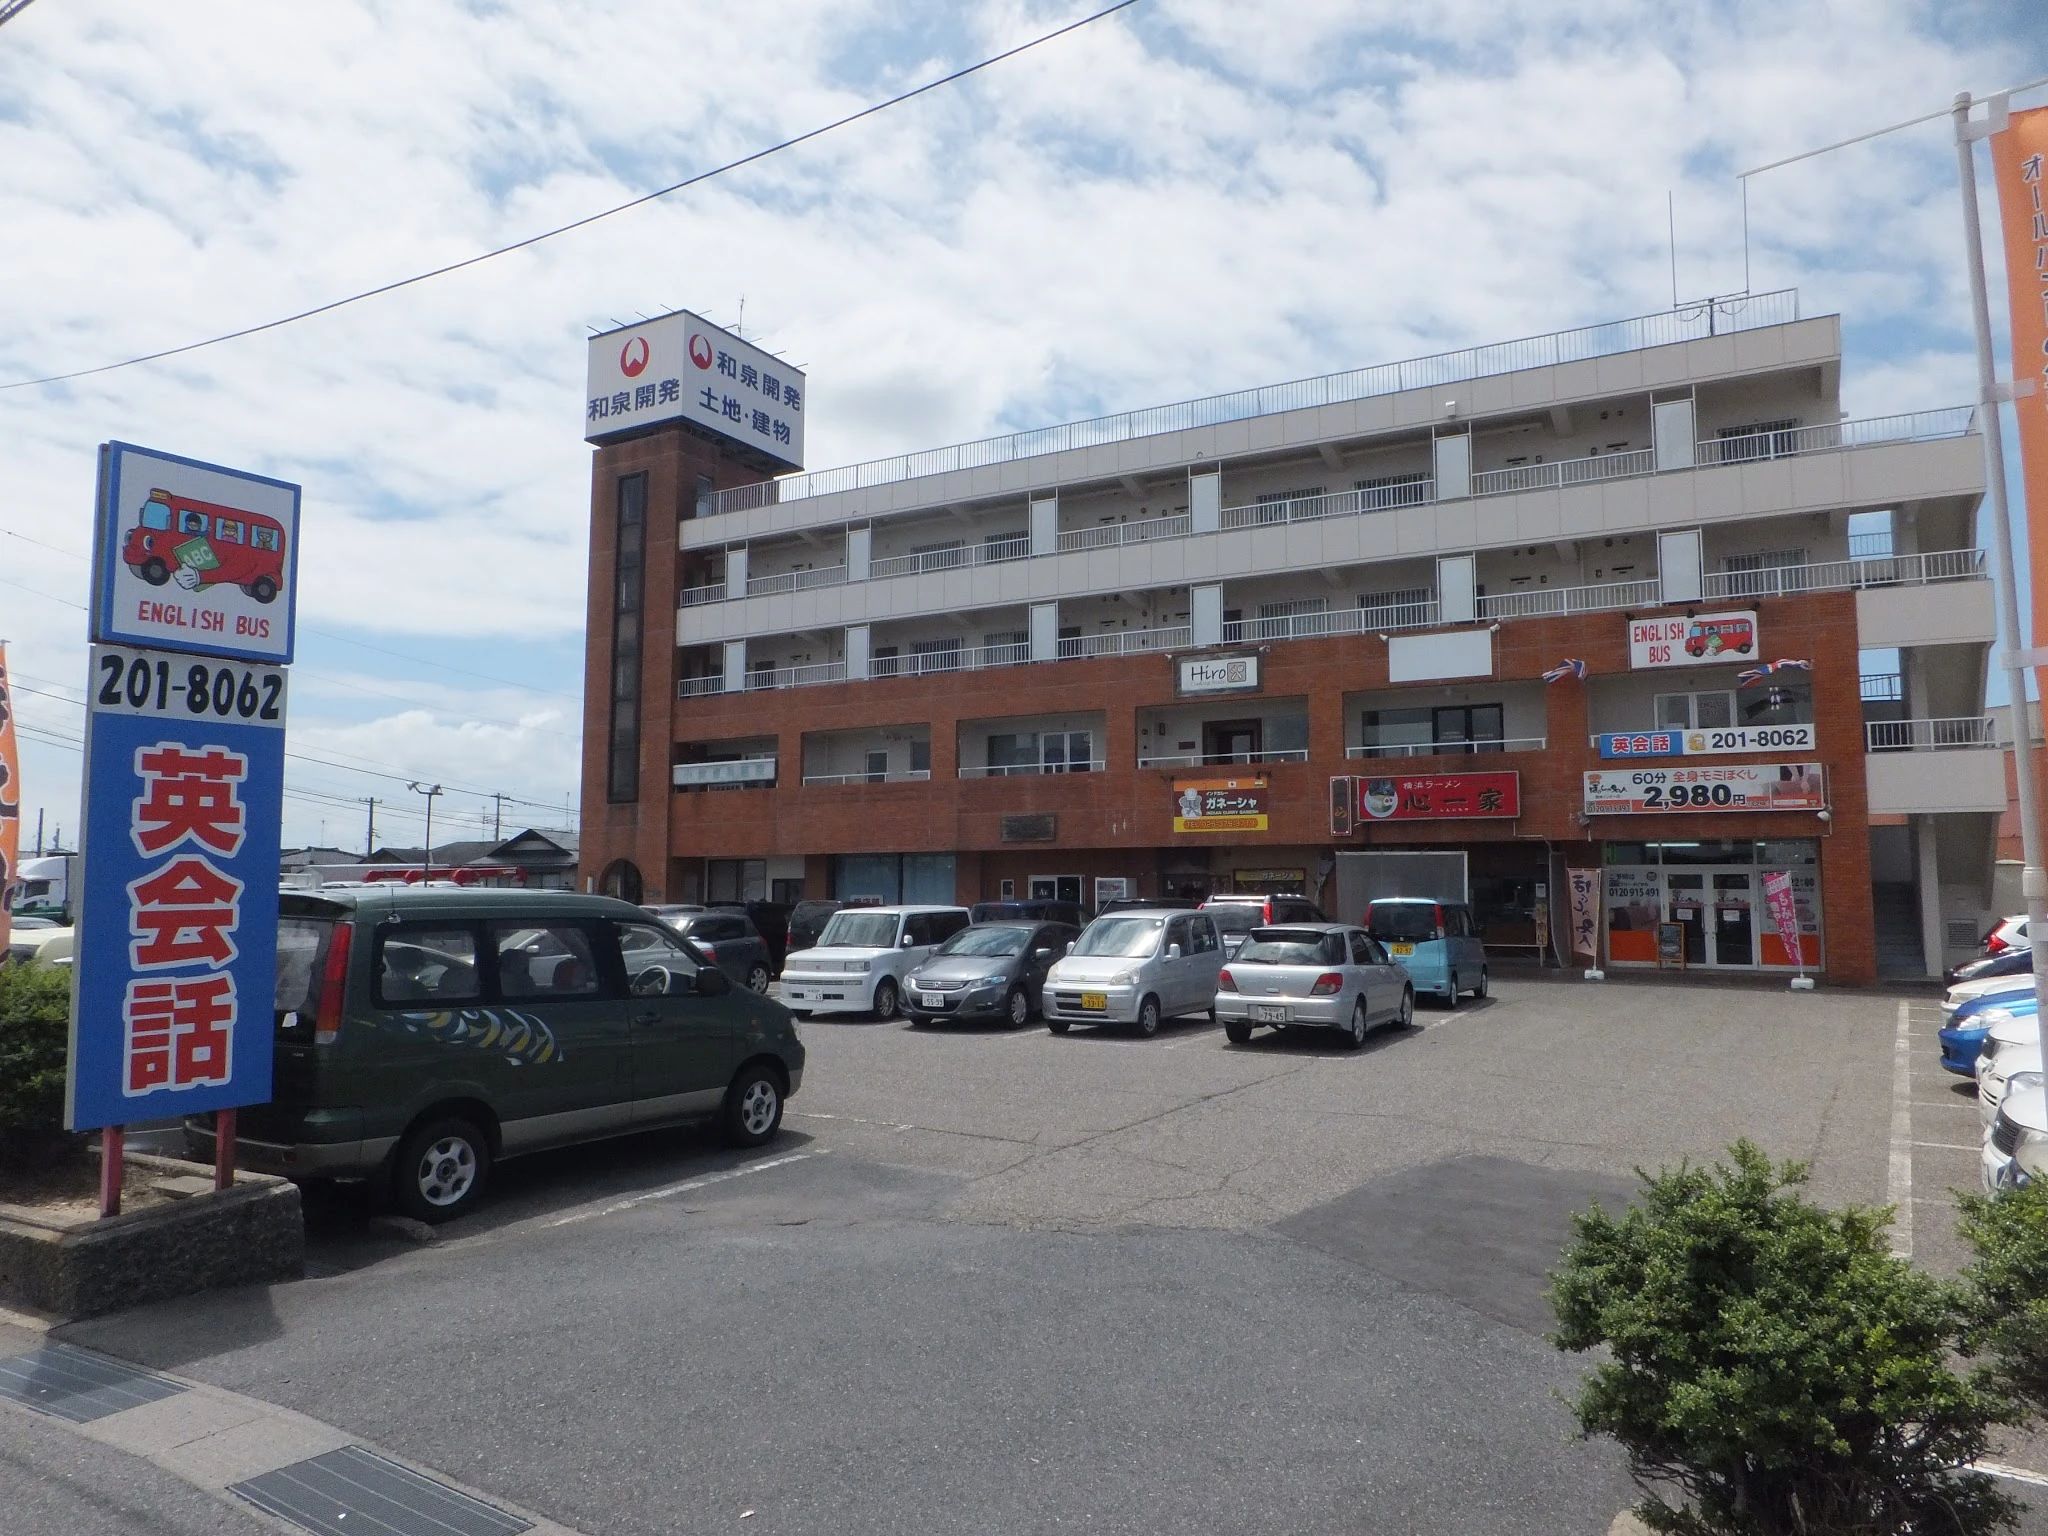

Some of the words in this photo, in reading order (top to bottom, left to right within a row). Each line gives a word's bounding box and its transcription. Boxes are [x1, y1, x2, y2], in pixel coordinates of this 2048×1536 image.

[716, 351, 801, 412] 和泉開発
[588, 377, 680, 422] 和泉開発
[138, 600, 225, 634] ENGLISH
[235, 614, 270, 639] BUS
[1633, 622, 1685, 643] ENGLISH
[1648, 645, 1672, 663] BUS
[1191, 664, 1226, 681] Hiro
[99, 654, 281, 721] 201-8062
[1611, 735, 1671, 754] 英会話
[1711, 729, 1809, 749] 201-8062
[1632, 772, 1667, 785] 60分
[1673, 769, 1758, 783] 全身モミほぐし
[1206, 797, 1257, 810] ガネーシャ
[1643, 783, 1747, 810] 2,980円
[1609, 888, 1629, 897] 0120
[1645, 887, 1660, 897] 491
[130, 746, 246, 1091] 英会話
